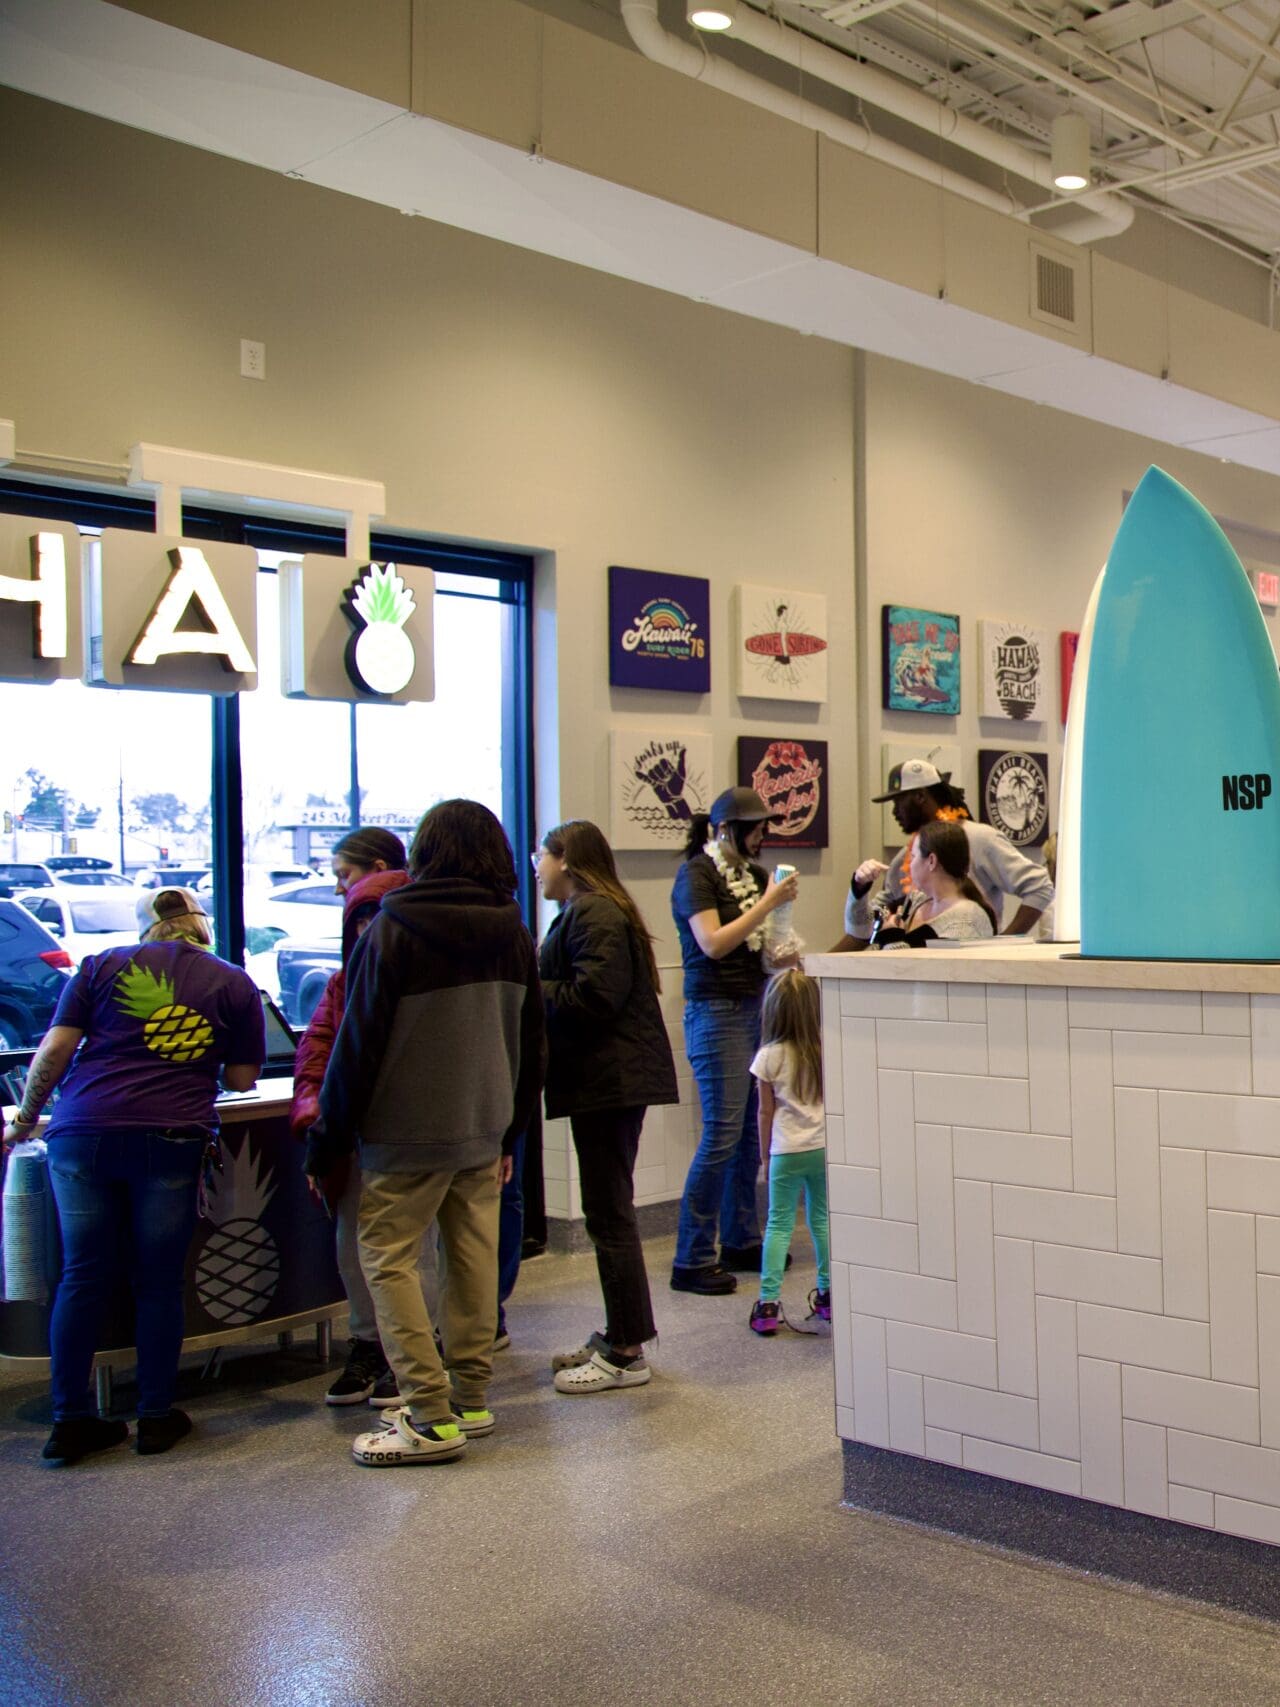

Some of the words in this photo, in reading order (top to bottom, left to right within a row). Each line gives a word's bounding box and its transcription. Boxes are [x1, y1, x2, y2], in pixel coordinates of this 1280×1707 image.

[622, 616, 698, 652] Hawaii
[750, 634, 781, 654] GONE
[788, 634, 824, 654] SURFING
[690, 637, 705, 659] 76
[1003, 681, 1036, 701] BEACH
[989, 756, 1016, 793] HAWAII
[1020, 758, 1045, 793] BEACH
[1222, 773, 1272, 811] NSP
[362, 1450, 402, 1461] crocs
